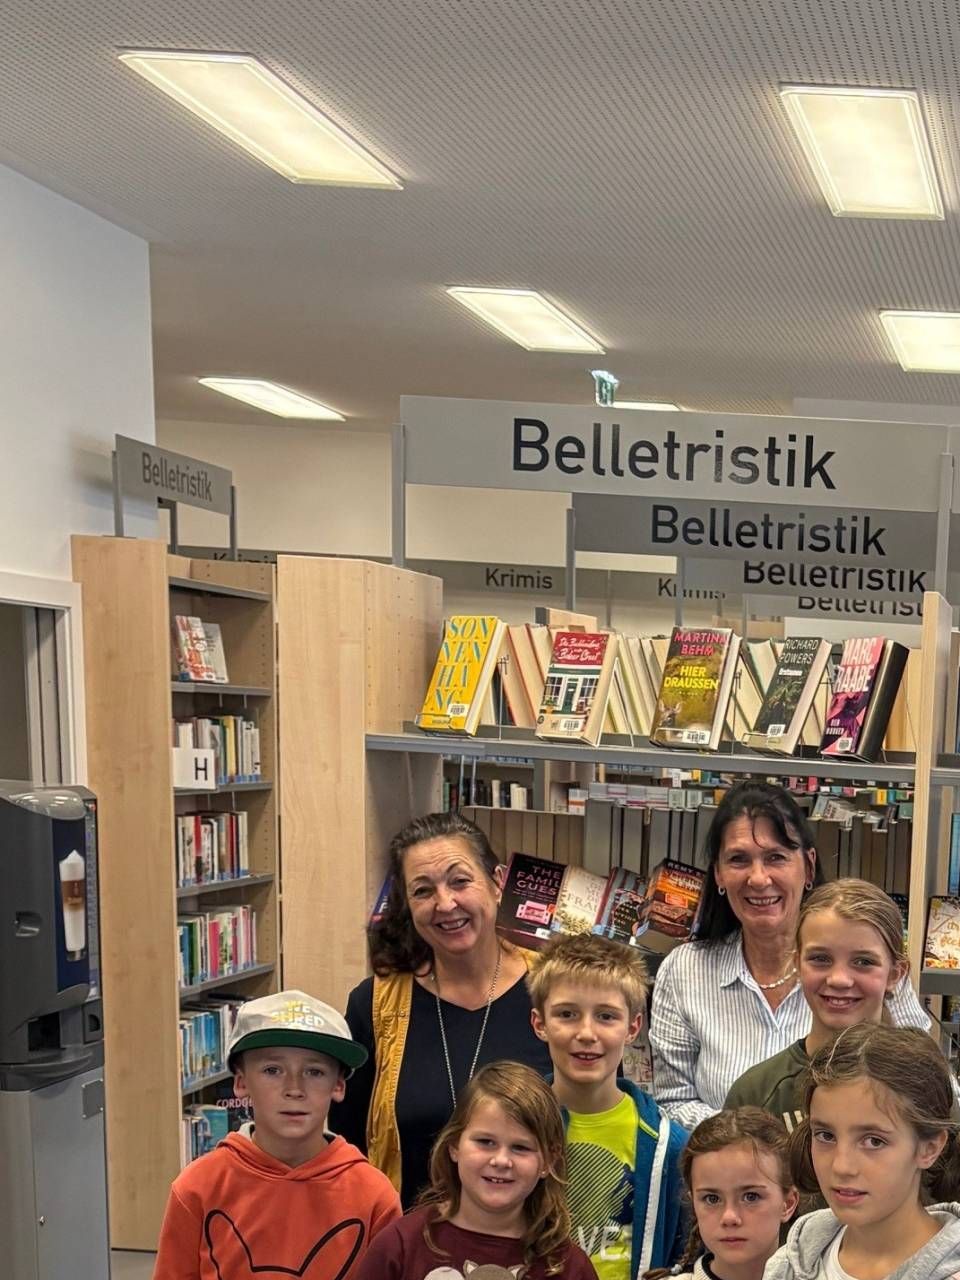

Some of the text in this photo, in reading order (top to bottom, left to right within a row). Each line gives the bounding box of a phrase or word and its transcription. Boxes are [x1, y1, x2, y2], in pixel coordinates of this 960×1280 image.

[513, 417, 836, 490] Belletristik
[142, 452, 213, 502] Belletristik
[650, 504, 886, 557] Belletristik
[485, 567, 553, 590] Krimis
[744, 560, 927, 593] Belletristik
[674, 630, 728, 646] MARTINA
[785, 638, 819, 651] RICHARD
[680, 643, 714, 657] BEHM
[778, 652, 814, 665] POWERS
[843, 638, 877, 665] MARC
[680, 666, 706, 678] HIER
[834, 664, 872, 693] RAABE
[663, 676, 719, 689] DRAUSSEN
[194, 757, 208, 781] H
[516, 871, 561, 888] FAMIL
[533, 865, 561, 880] THE
[517, 880, 558, 895] GUES
[271, 1010, 324, 1027] SHRED
